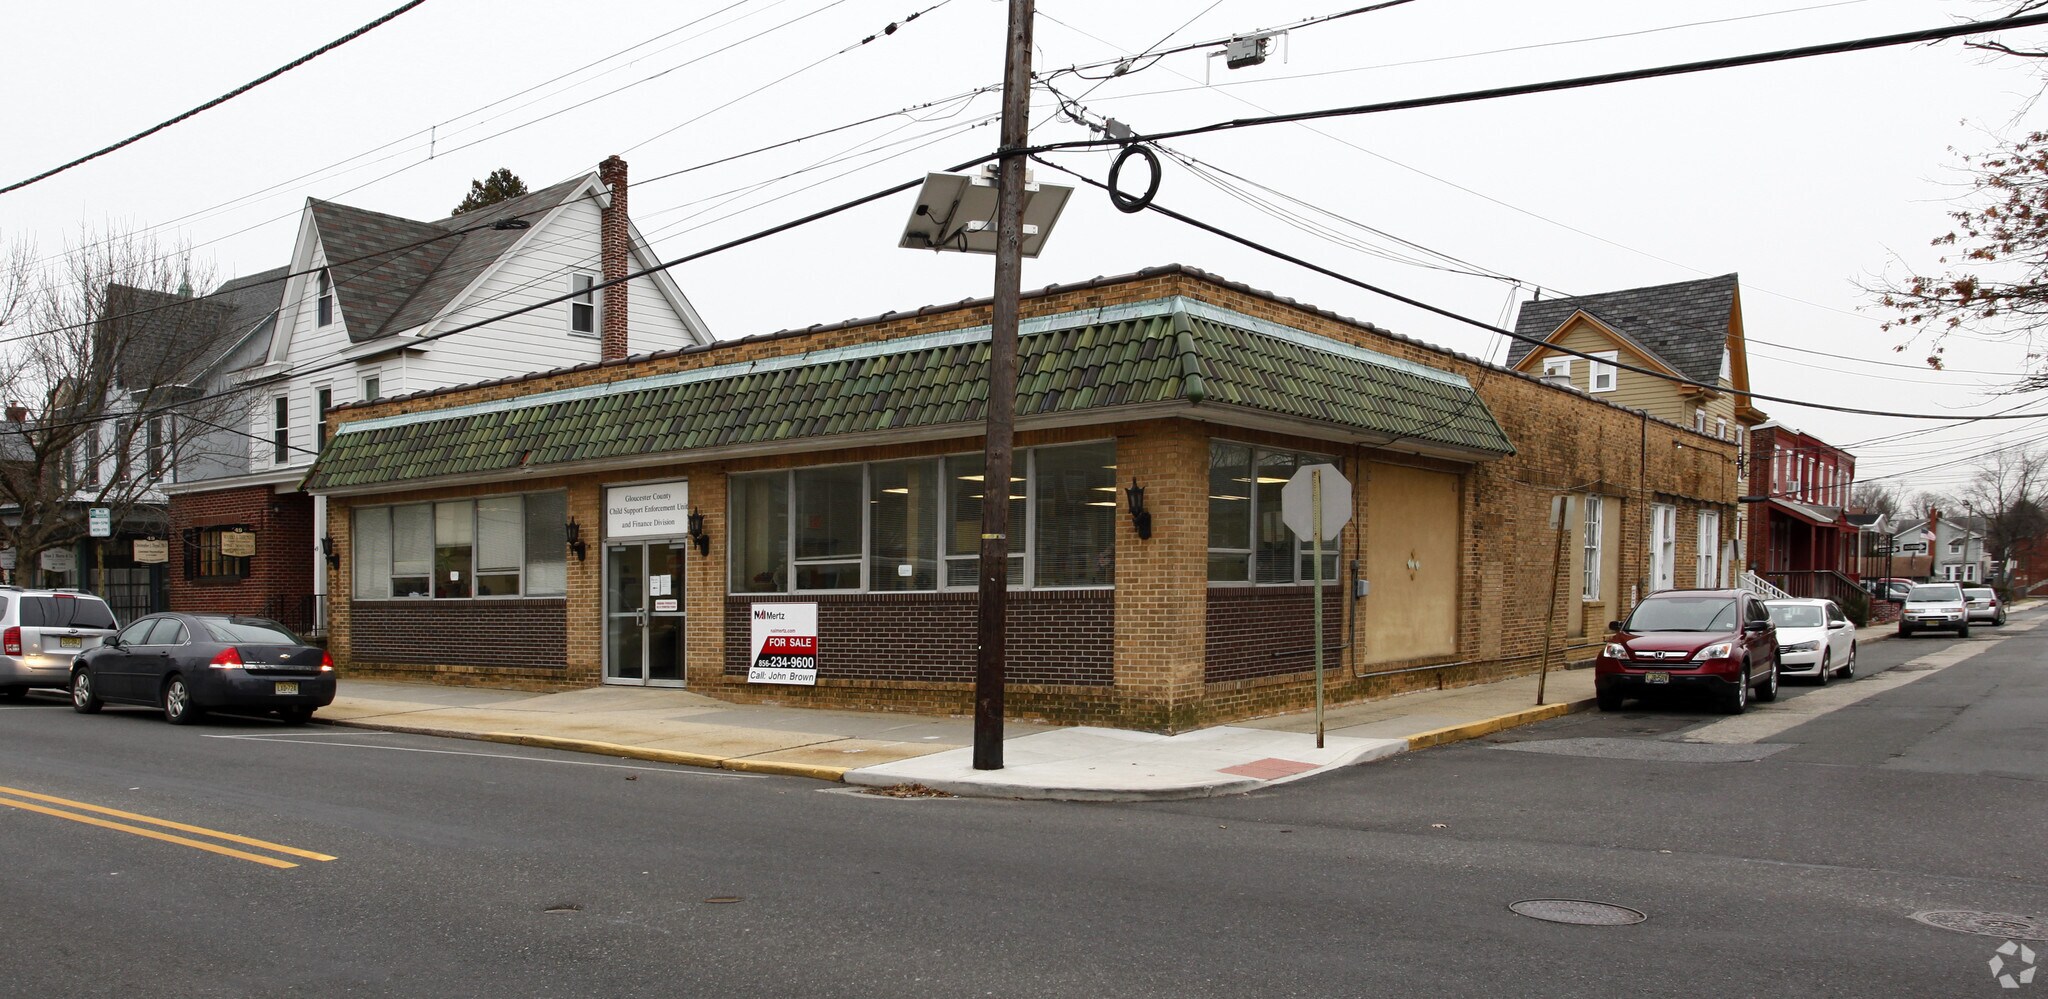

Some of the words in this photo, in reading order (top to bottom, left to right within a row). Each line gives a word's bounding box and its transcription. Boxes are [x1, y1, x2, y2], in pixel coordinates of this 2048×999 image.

[625, 494, 652, 502] Gloucester
[653, 492, 671, 501] County
[609, 507, 623, 515] Child
[624, 506, 643, 516] Support
[644, 504, 676, 513] Enforcement
[622, 520, 631, 528] and
[632, 520, 652, 528] Finance
[754, 608, 766, 619] NAI
[767, 611, 785, 619] Mertz
[769, 638, 786, 647] FOR
[789, 638, 812, 647] SALE
[758, 656, 814, 668] 856-234-9600
[750, 671, 766, 680] Call:
[768, 672, 786, 680] John
[789, 672, 814, 681] Brown
